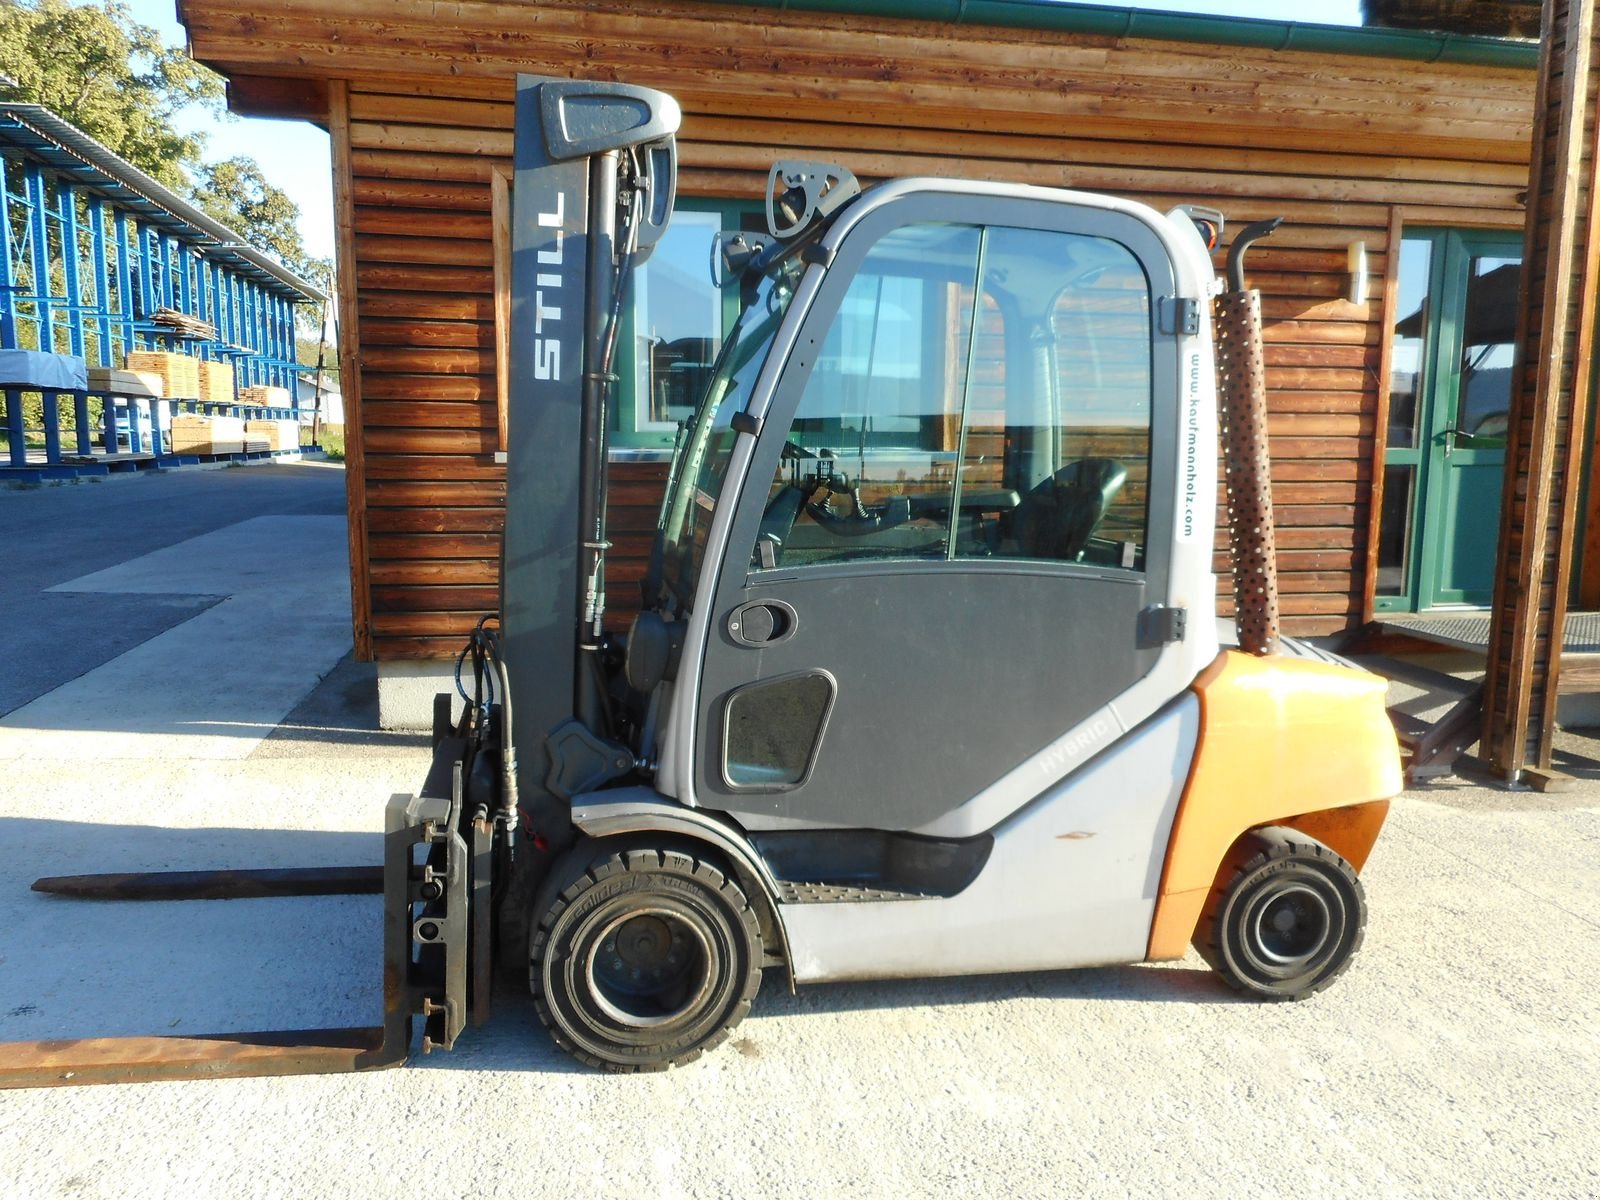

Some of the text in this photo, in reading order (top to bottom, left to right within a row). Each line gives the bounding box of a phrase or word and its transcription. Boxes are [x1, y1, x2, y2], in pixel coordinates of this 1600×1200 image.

[534, 191, 565, 381] STILL
[1183, 353, 1201, 538] www.kaufmannholz.com
[1039, 719, 1108, 775] HYBRID
